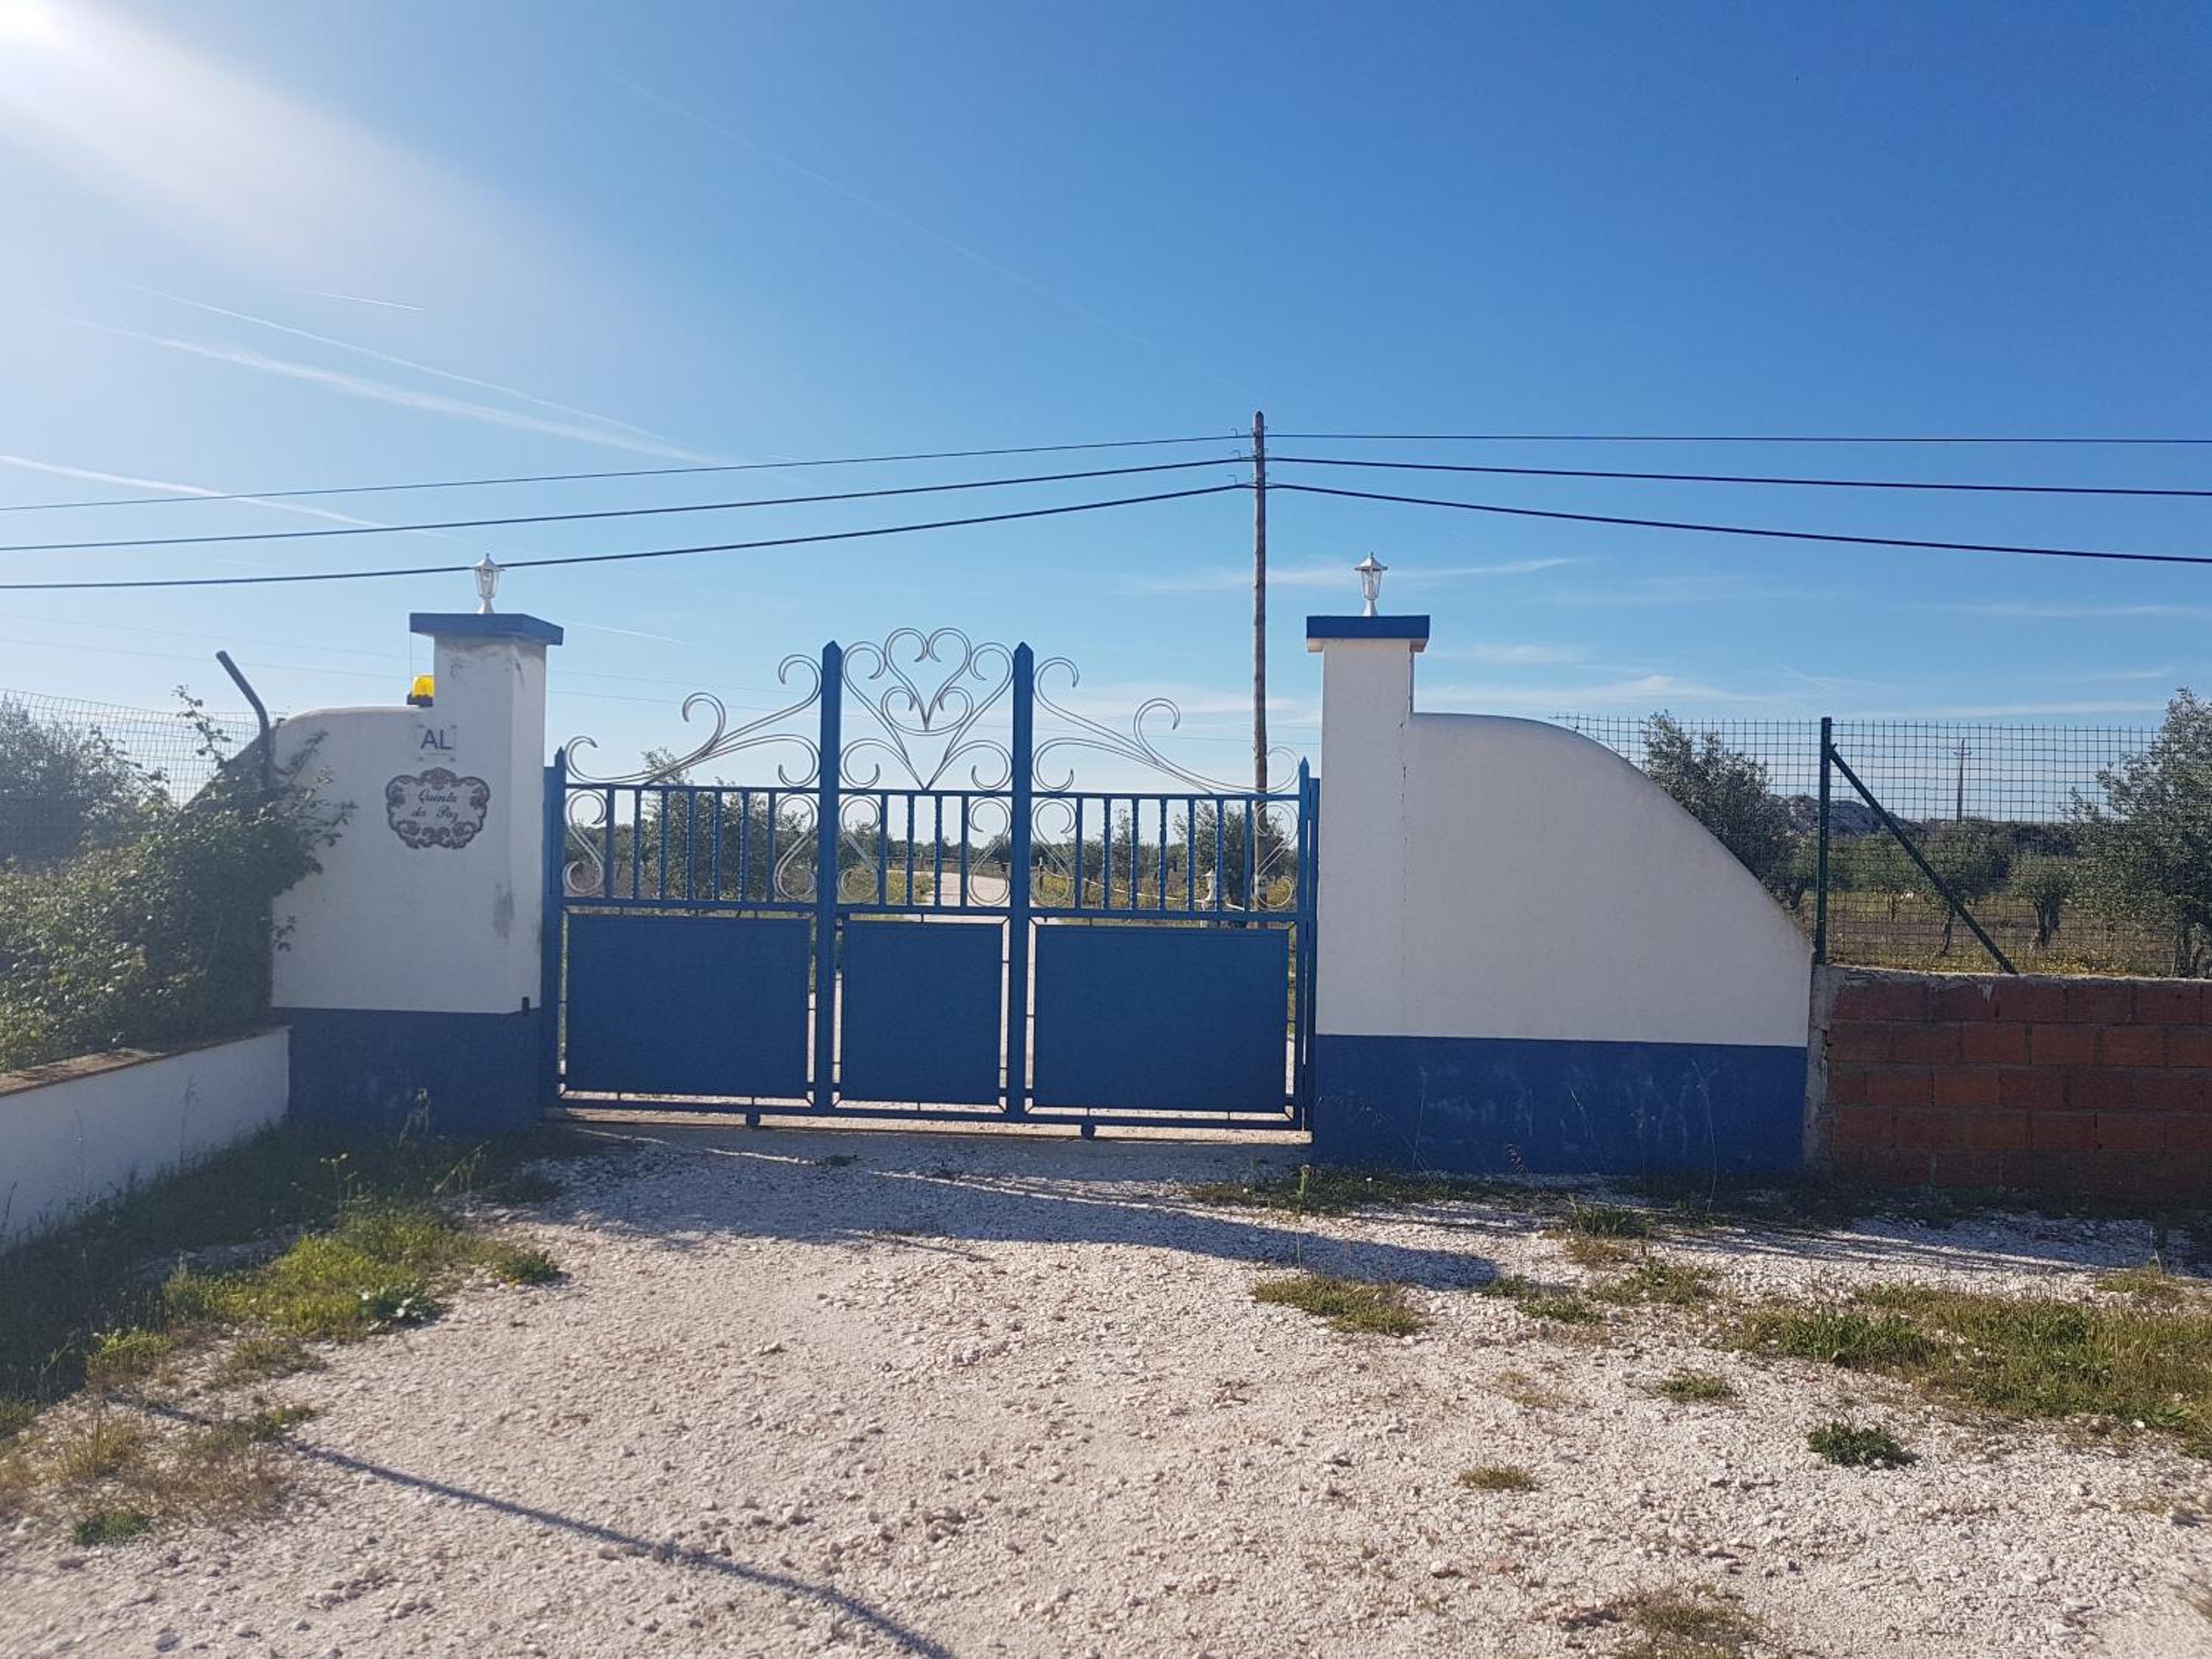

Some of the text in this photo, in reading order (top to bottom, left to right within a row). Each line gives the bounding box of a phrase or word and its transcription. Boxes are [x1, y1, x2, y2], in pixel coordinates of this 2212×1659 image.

[420, 729, 453, 750] AL
[419, 789, 457, 804] Quinta
[411, 806, 459, 823] da Paz
